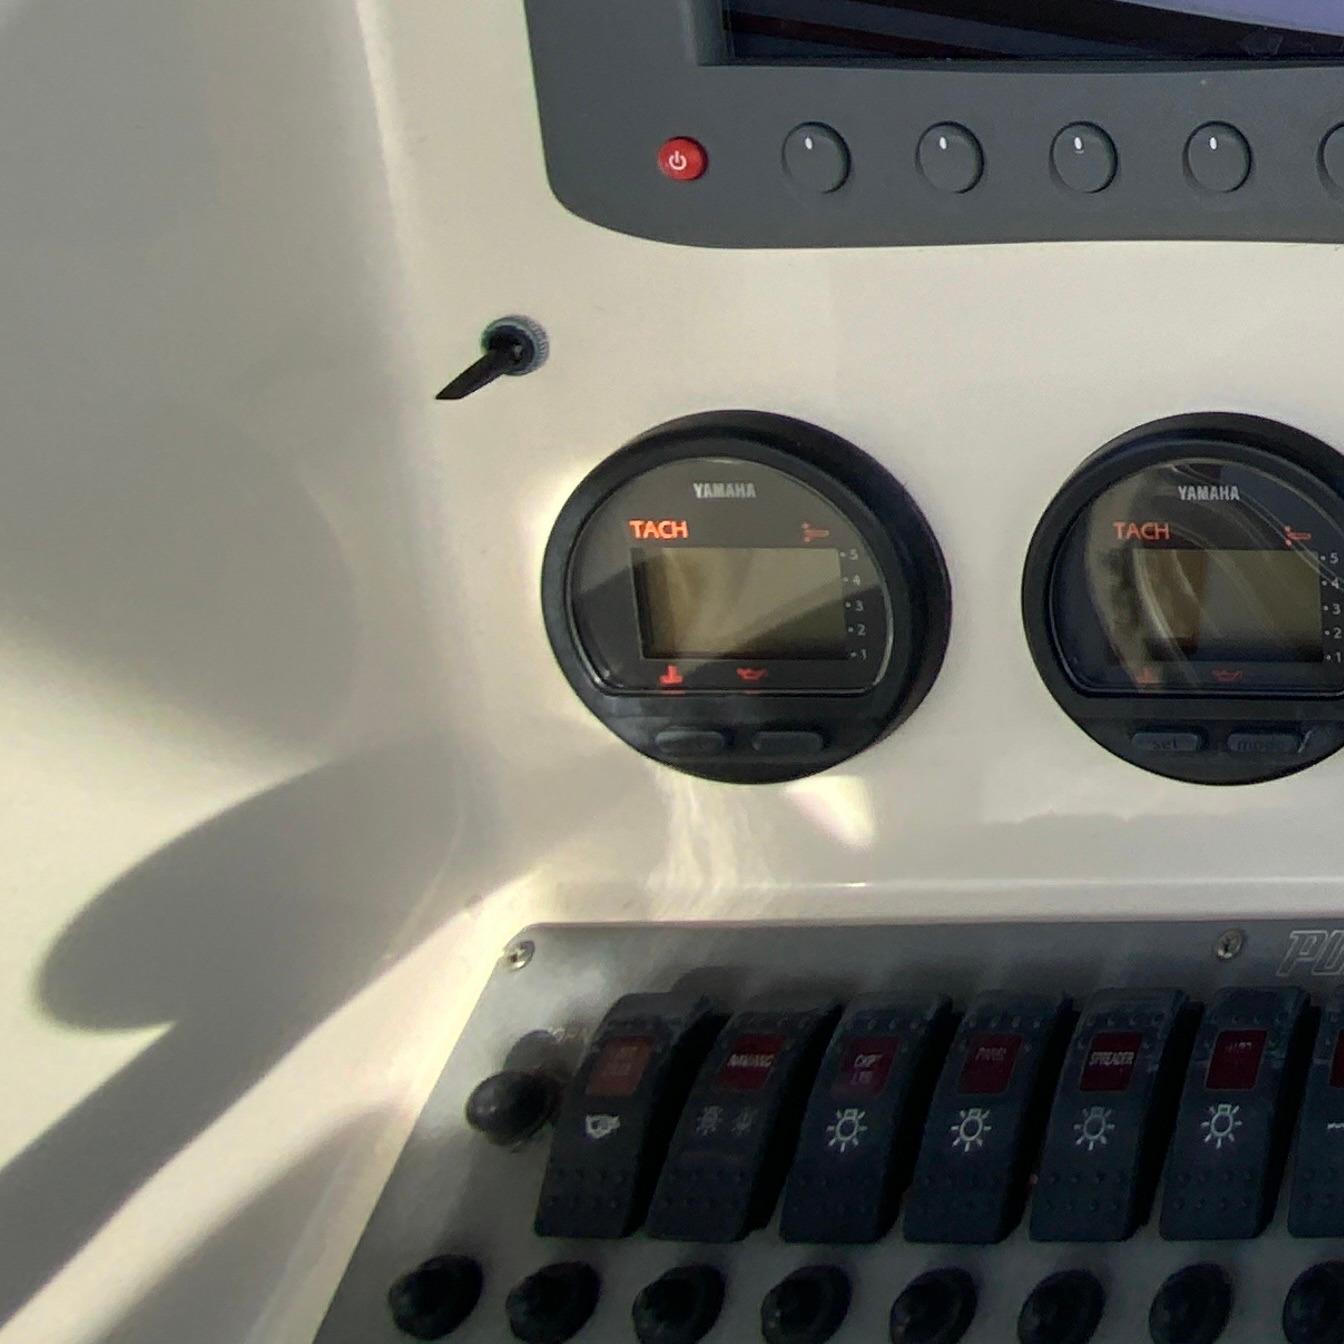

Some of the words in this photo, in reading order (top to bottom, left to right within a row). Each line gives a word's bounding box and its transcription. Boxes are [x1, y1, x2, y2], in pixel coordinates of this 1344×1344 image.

[693, 482, 757, 499] YAMAHA
[1177, 485, 1240, 502] YAMAHA
[629, 519, 689, 539] TACH
[1113, 522, 1170, 540] TACH
[1089, 1051, 1135, 1066] SPREADER
